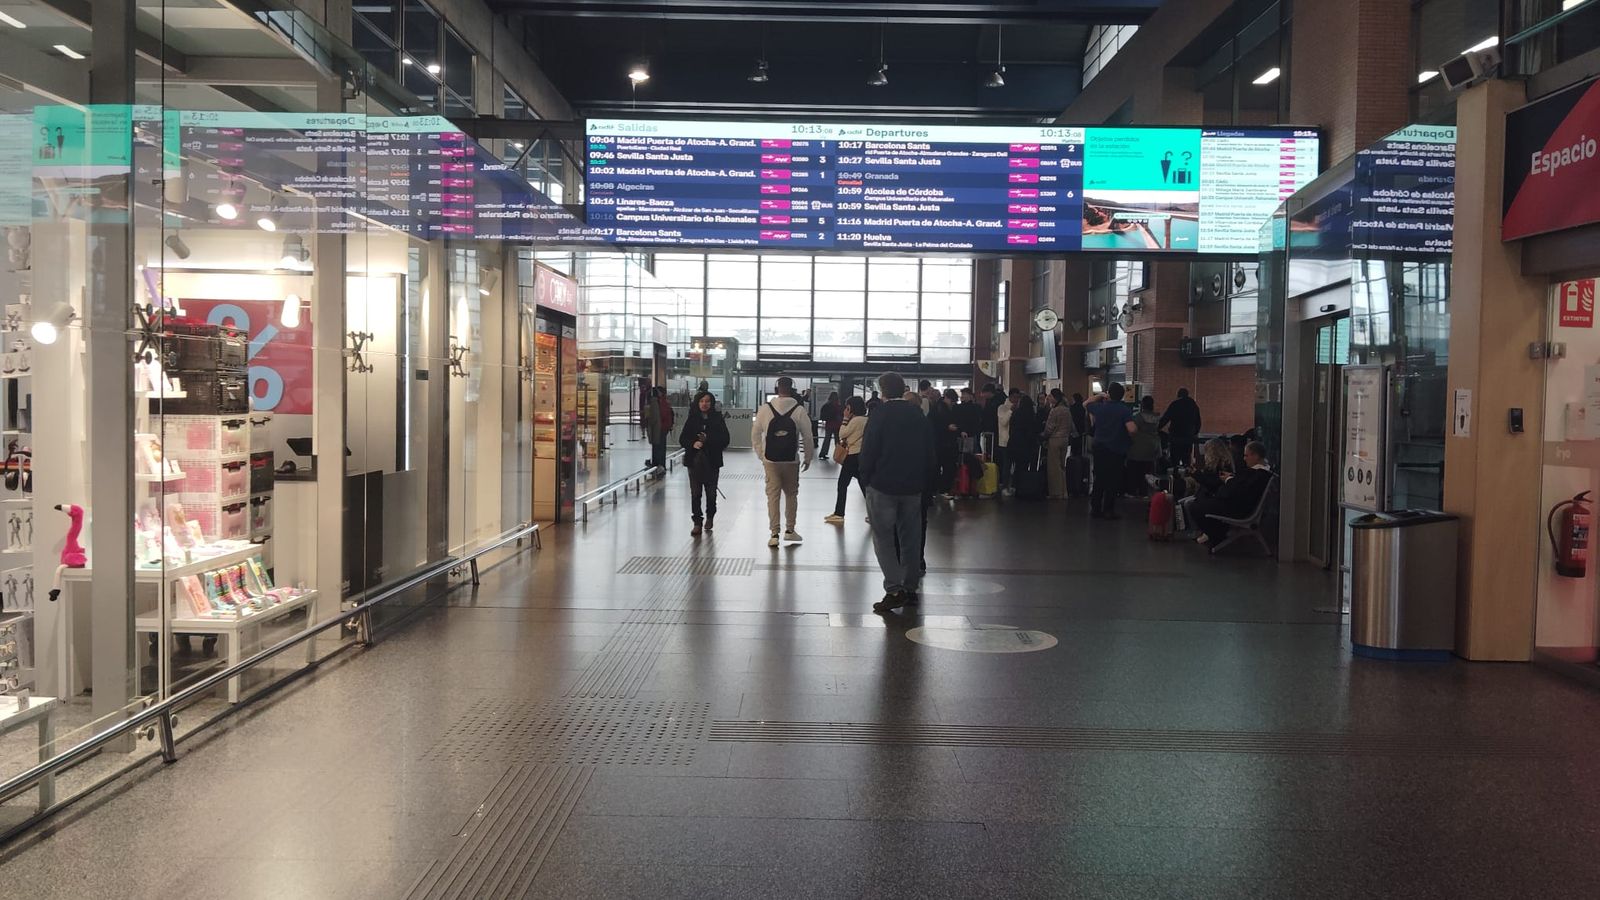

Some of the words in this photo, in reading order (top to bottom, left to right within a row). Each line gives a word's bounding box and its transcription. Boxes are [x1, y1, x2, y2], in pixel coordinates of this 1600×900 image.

[617, 123, 658, 132] Salidas
[866, 128, 928, 138] Departures
[617, 137, 645, 145] Madrid
[646, 138, 674, 146] Puerta
[729, 139, 756, 147] Grand.
[838, 141, 863, 149] 10:17
[907, 142, 930, 150] Sants
[617, 152, 644, 160] Sevilla
[670, 153, 693, 161] Justa
[1531, 134, 1597, 176] Espacio
[819, 156, 826, 164] 3
[865, 157, 892, 165] Sevilla
[918, 158, 941, 166] Justa
[617, 167, 645, 175] Madrid
[646, 168, 673, 176] Puerta
[674, 168, 685, 176] de
[729, 170, 756, 178] Grand.
[820, 171, 825, 179] 1
[617, 183, 655, 192] Algeciras
[908, 188, 944, 196] Córdoba
[616, 198, 674, 206] Linares-Baeza
[892, 203, 916, 211] Santa
[616, 213, 650, 222] Campus
[651, 214, 702, 222] Universitario
[864, 218, 892, 226] Madrid
[976, 220, 1003, 228] Grand.
[616, 228, 657, 236] Barcelona
[658, 229, 681, 237] Sants
[864, 233, 892, 241] Huelva
